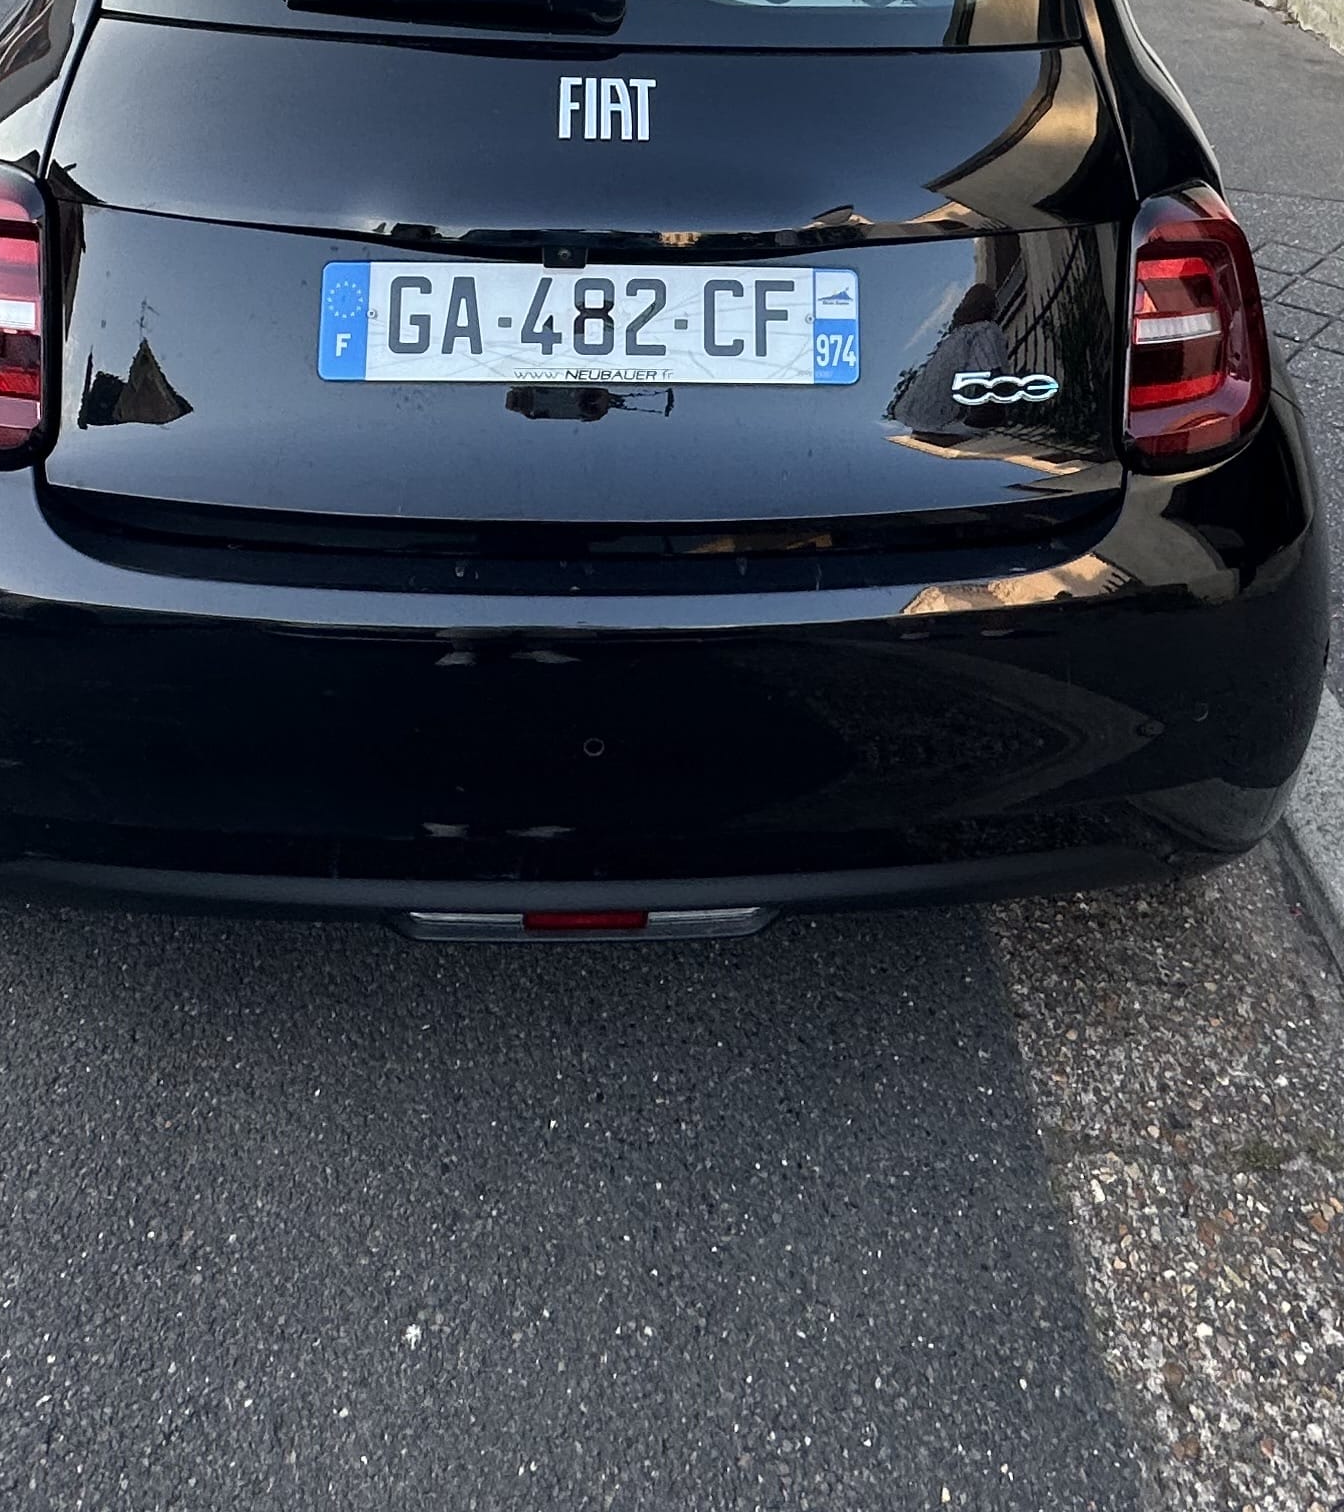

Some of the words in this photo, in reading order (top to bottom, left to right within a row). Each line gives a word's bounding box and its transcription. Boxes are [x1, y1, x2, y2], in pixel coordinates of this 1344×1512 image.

[559, 77, 656, 140] FIAT
[388, 275, 795, 357] GA-482-CF
[336, 333, 351, 357] F
[816, 333, 856, 367] 974
